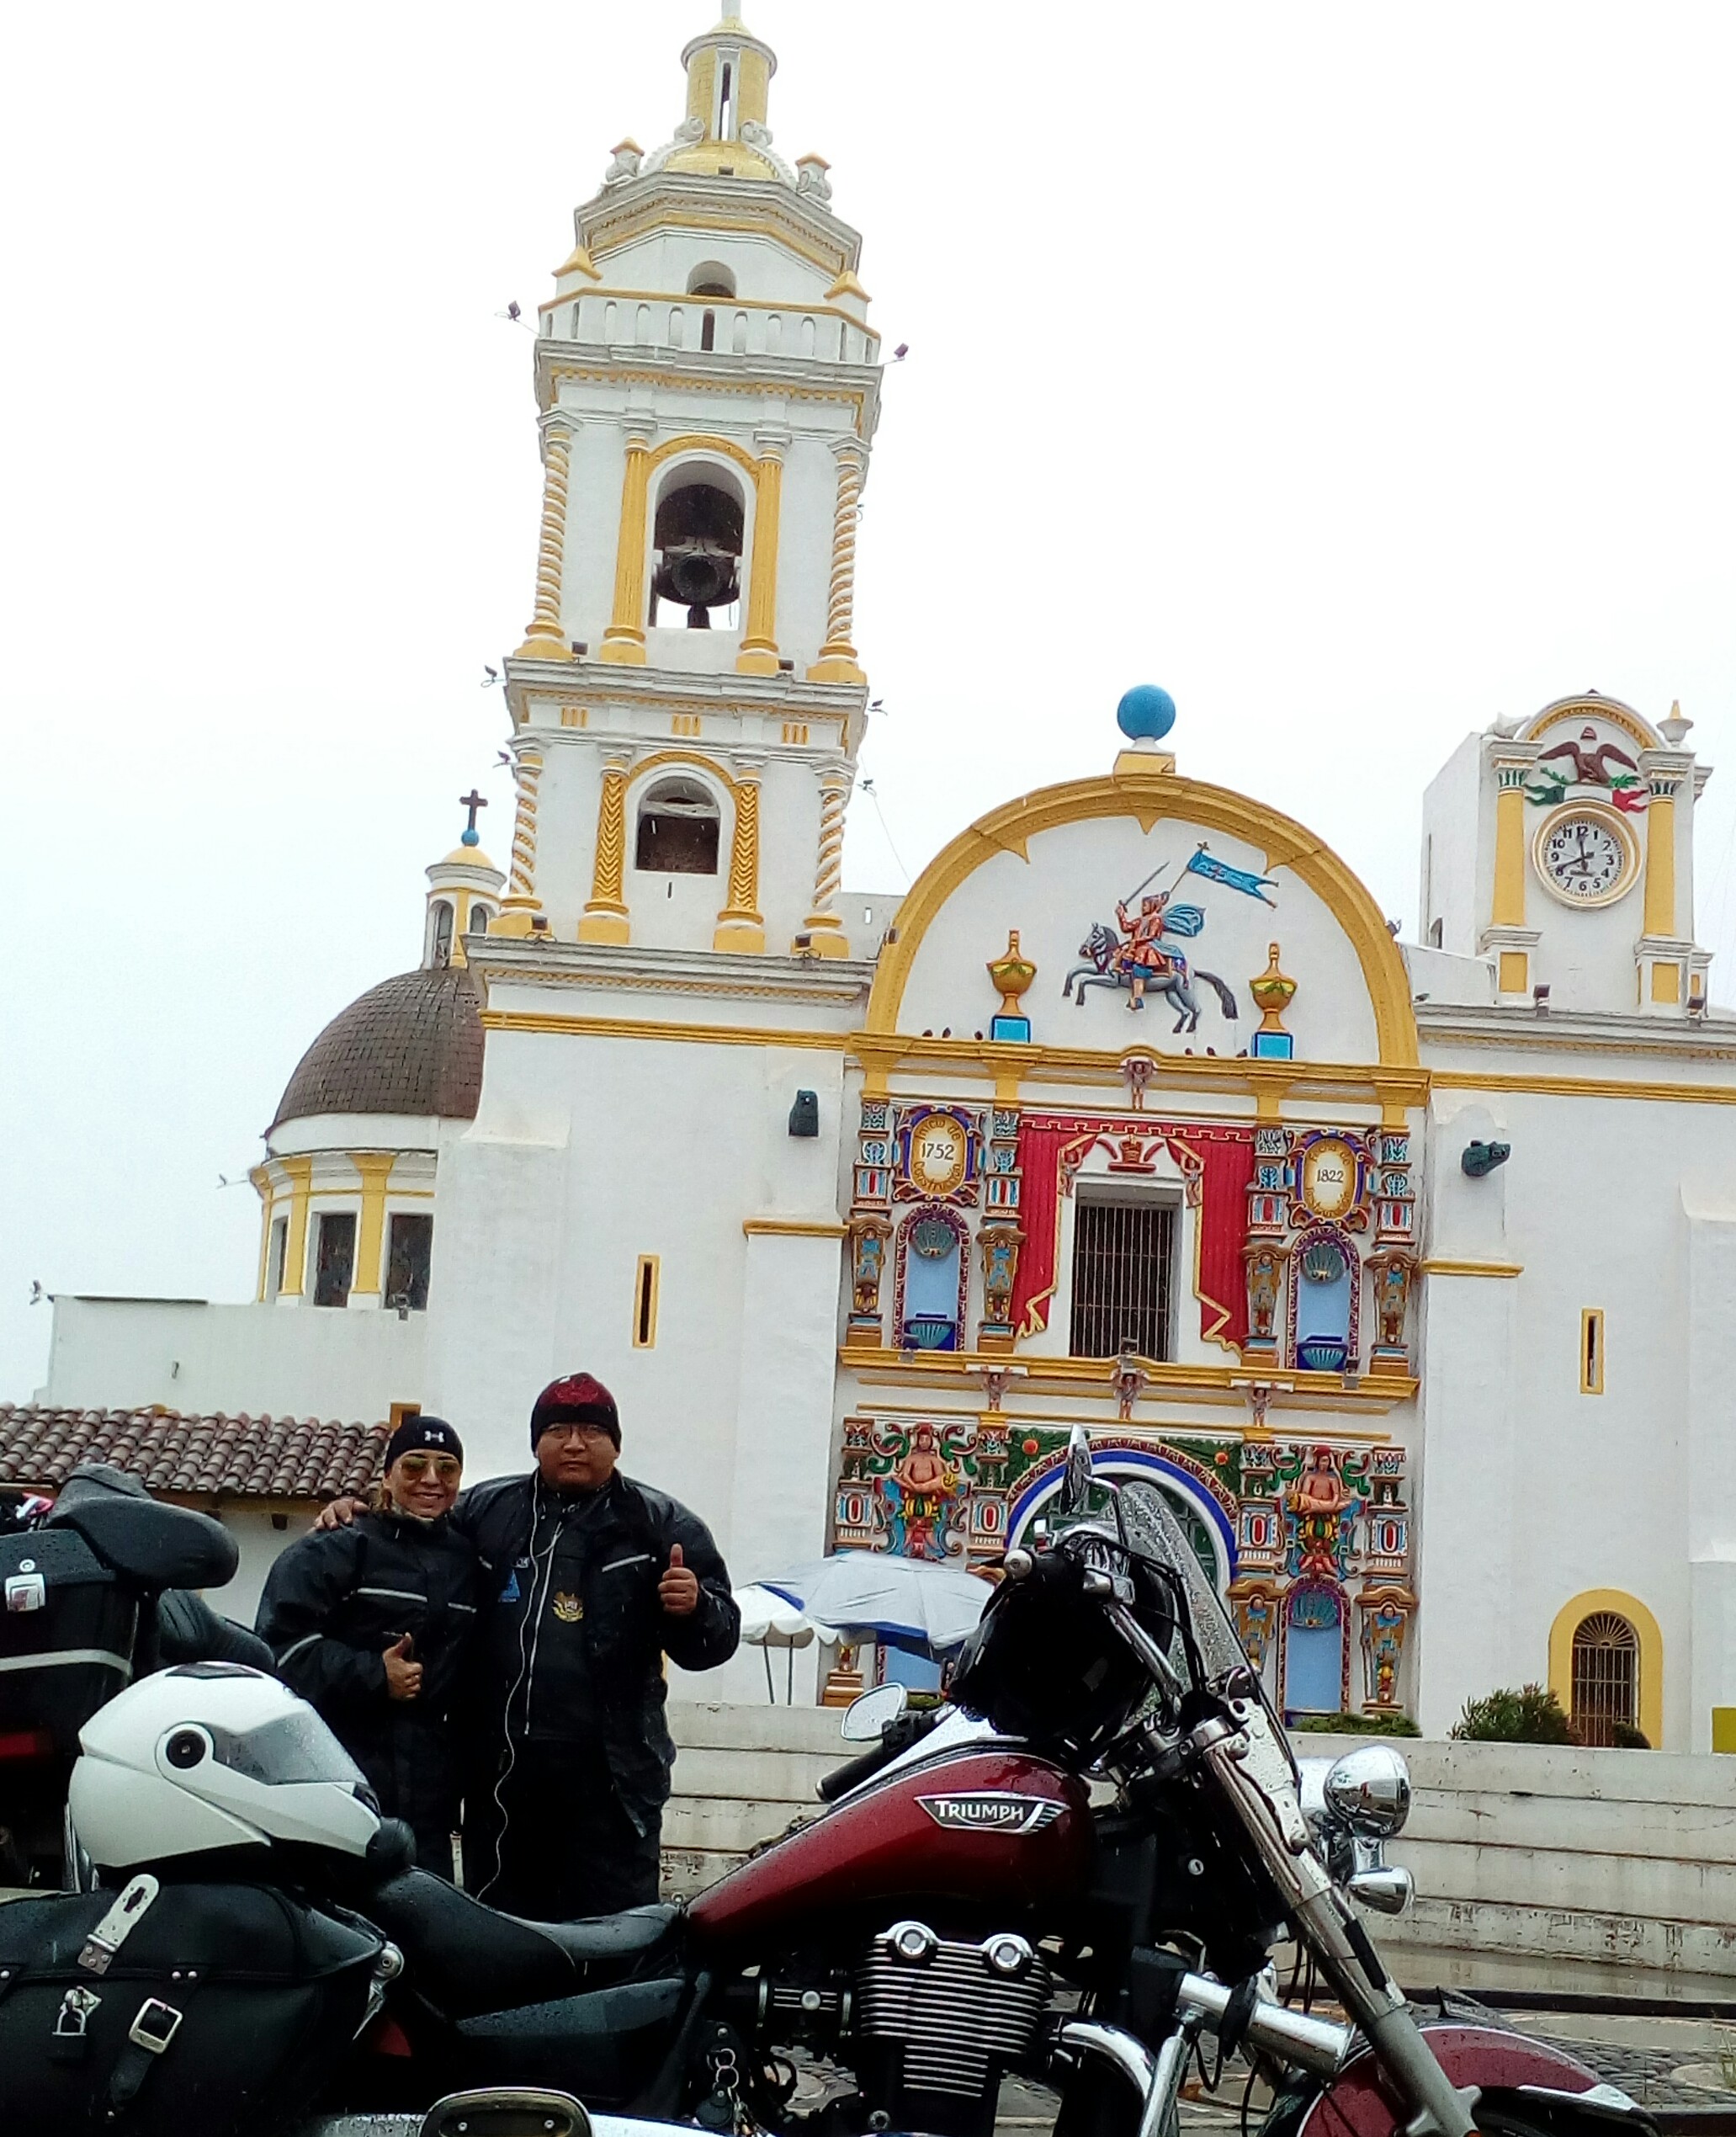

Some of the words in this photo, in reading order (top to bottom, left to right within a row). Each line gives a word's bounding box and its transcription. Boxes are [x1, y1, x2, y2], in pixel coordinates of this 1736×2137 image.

[1563, 829, 1572, 839] 11
[1576, 826, 1589, 837] 12
[1593, 830, 1598, 840] 1
[1553, 839, 1565, 848] 10
[1602, 840, 1611, 851] 2
[1551, 852, 1559, 862] 9
[1606, 854, 1614, 865] 3
[1555, 866, 1563, 876] 8
[1601, 868, 1609, 878] 4
[1564, 877, 1574, 888] 7
[1579, 881, 1587, 891] 6
[1592, 878, 1601, 889] 5
[947, 1124, 961, 1141] de
[921, 1142, 954, 1161] 1752
[1316, 1168, 1345, 1183] 1822
[934, 1799, 1024, 1823] TRIUMPH
